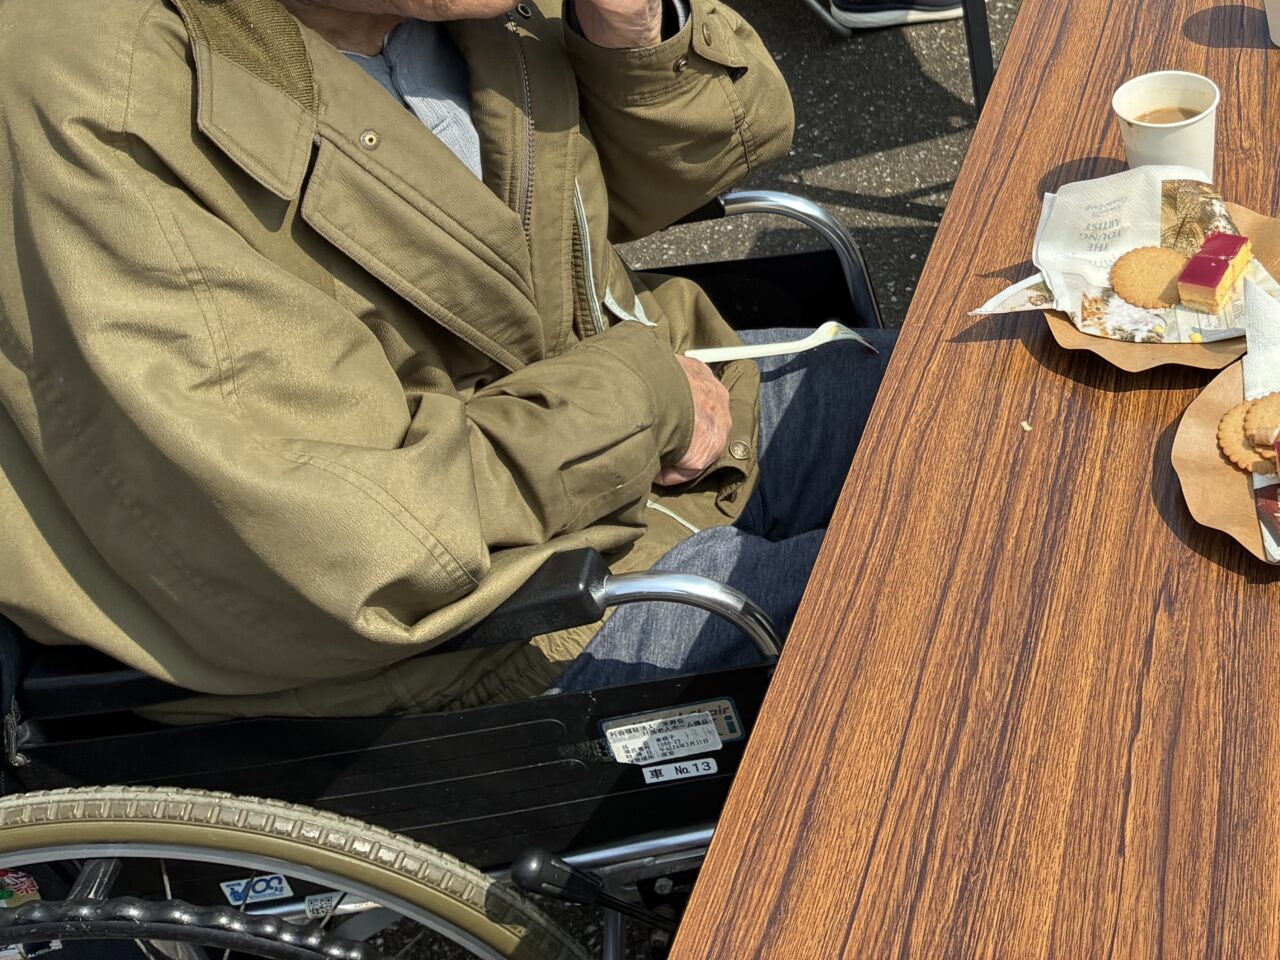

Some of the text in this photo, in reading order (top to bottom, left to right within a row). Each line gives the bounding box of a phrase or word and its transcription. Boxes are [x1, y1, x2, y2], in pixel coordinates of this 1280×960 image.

[1084, 218, 1120, 231] ARTIST
[1079, 232, 1122, 241] YOUNG
[1086, 243, 1108, 252] THE
[649, 769, 664, 780] 車
